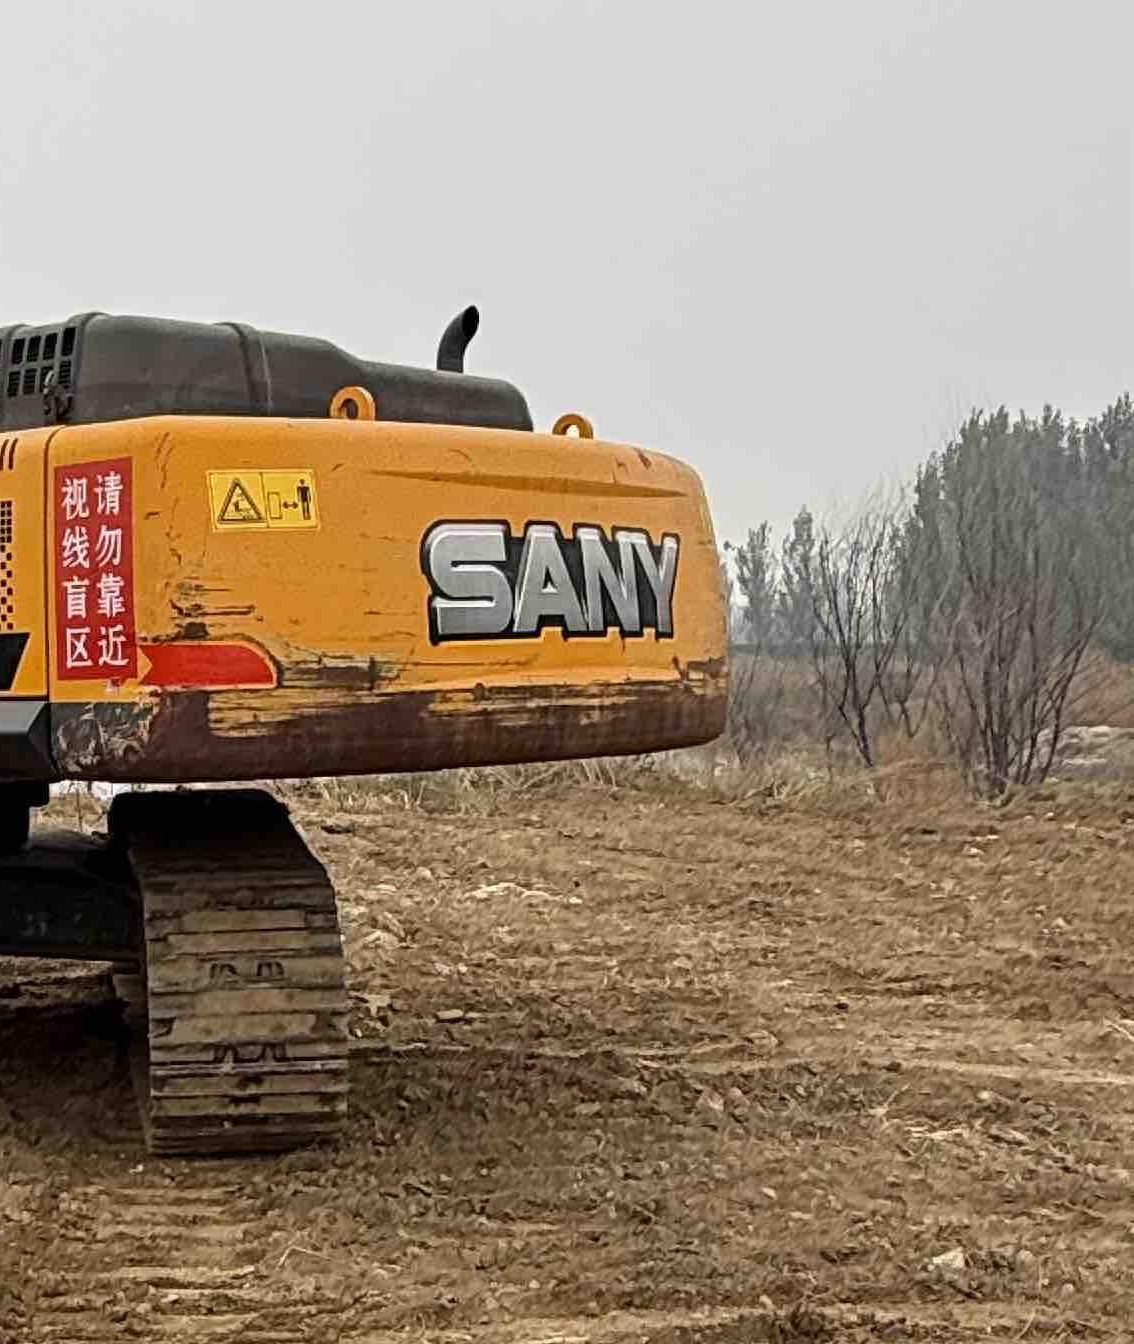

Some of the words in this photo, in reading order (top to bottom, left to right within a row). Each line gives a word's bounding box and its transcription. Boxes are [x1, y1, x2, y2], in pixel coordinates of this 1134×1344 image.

[61, 477, 93, 669] 视线盲区
[94, 471, 130, 667] 请勿靠近
[424, 520, 680, 638] SANY
